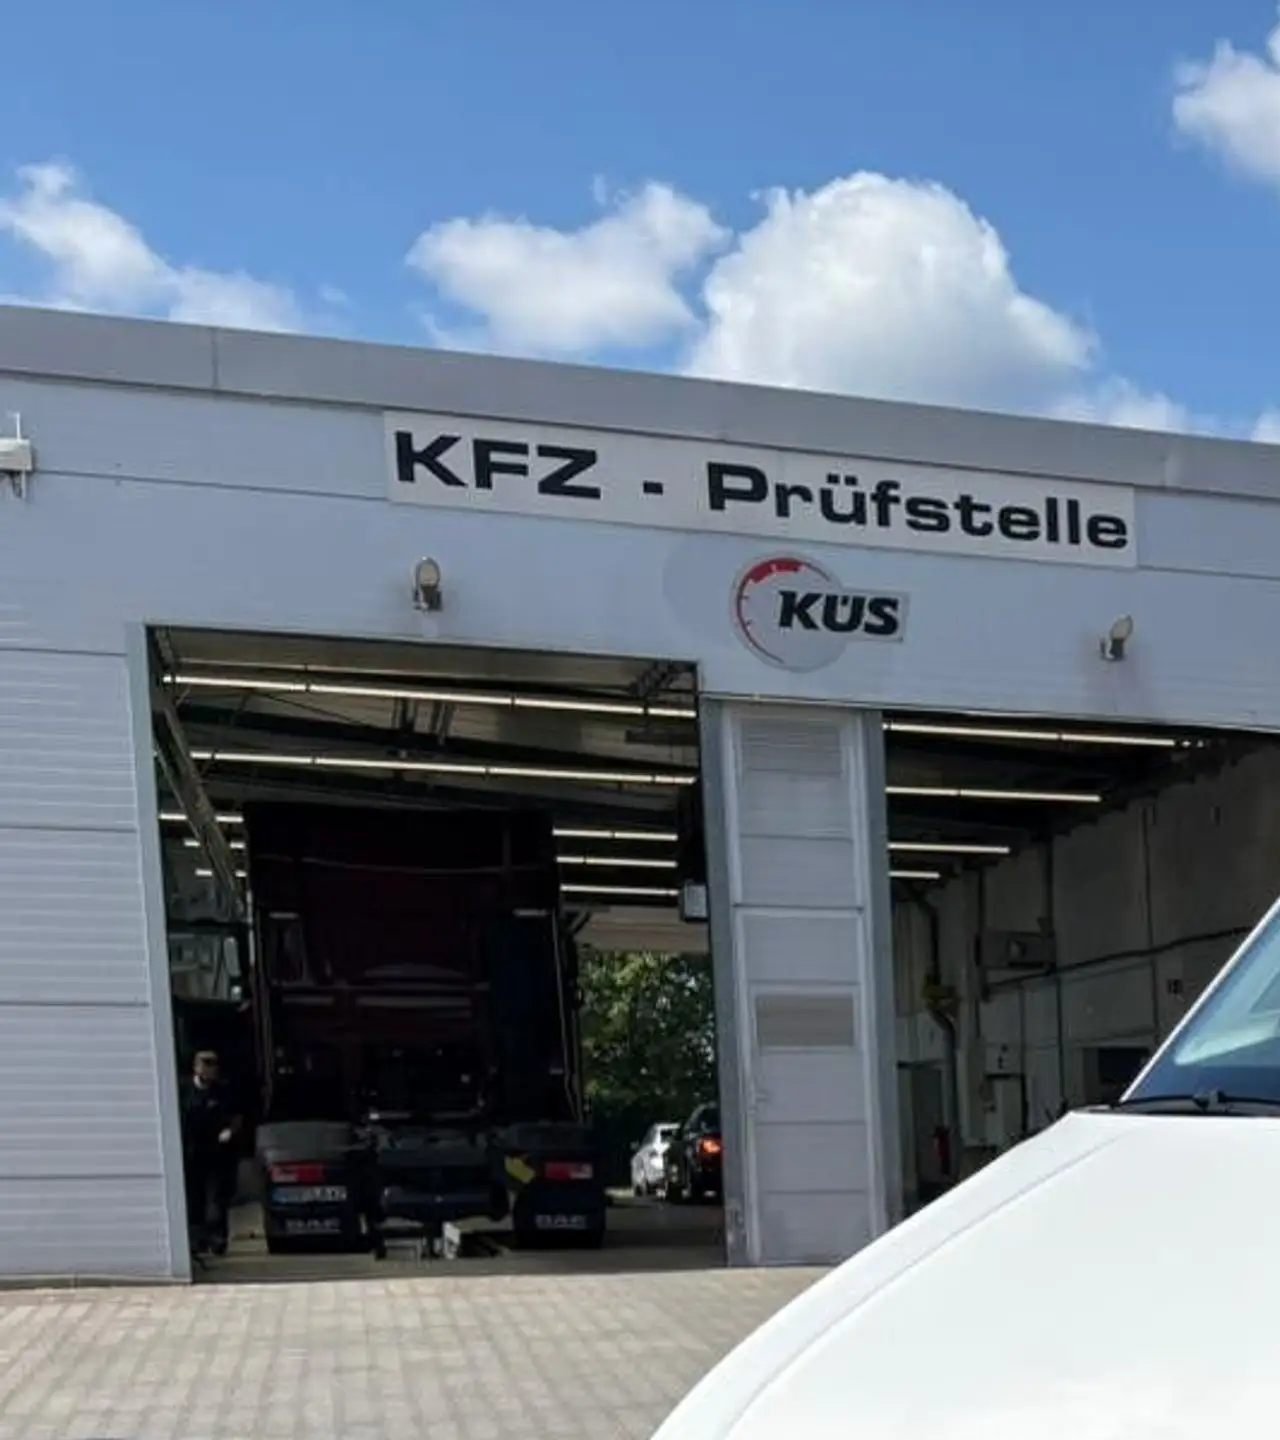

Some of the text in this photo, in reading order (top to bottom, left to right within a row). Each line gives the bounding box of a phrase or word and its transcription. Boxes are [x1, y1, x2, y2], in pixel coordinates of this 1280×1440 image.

[395, 430, 601, 499] KFZ
[707, 462, 1128, 550] Prüfstelle
[778, 589, 901, 637] KÜS
